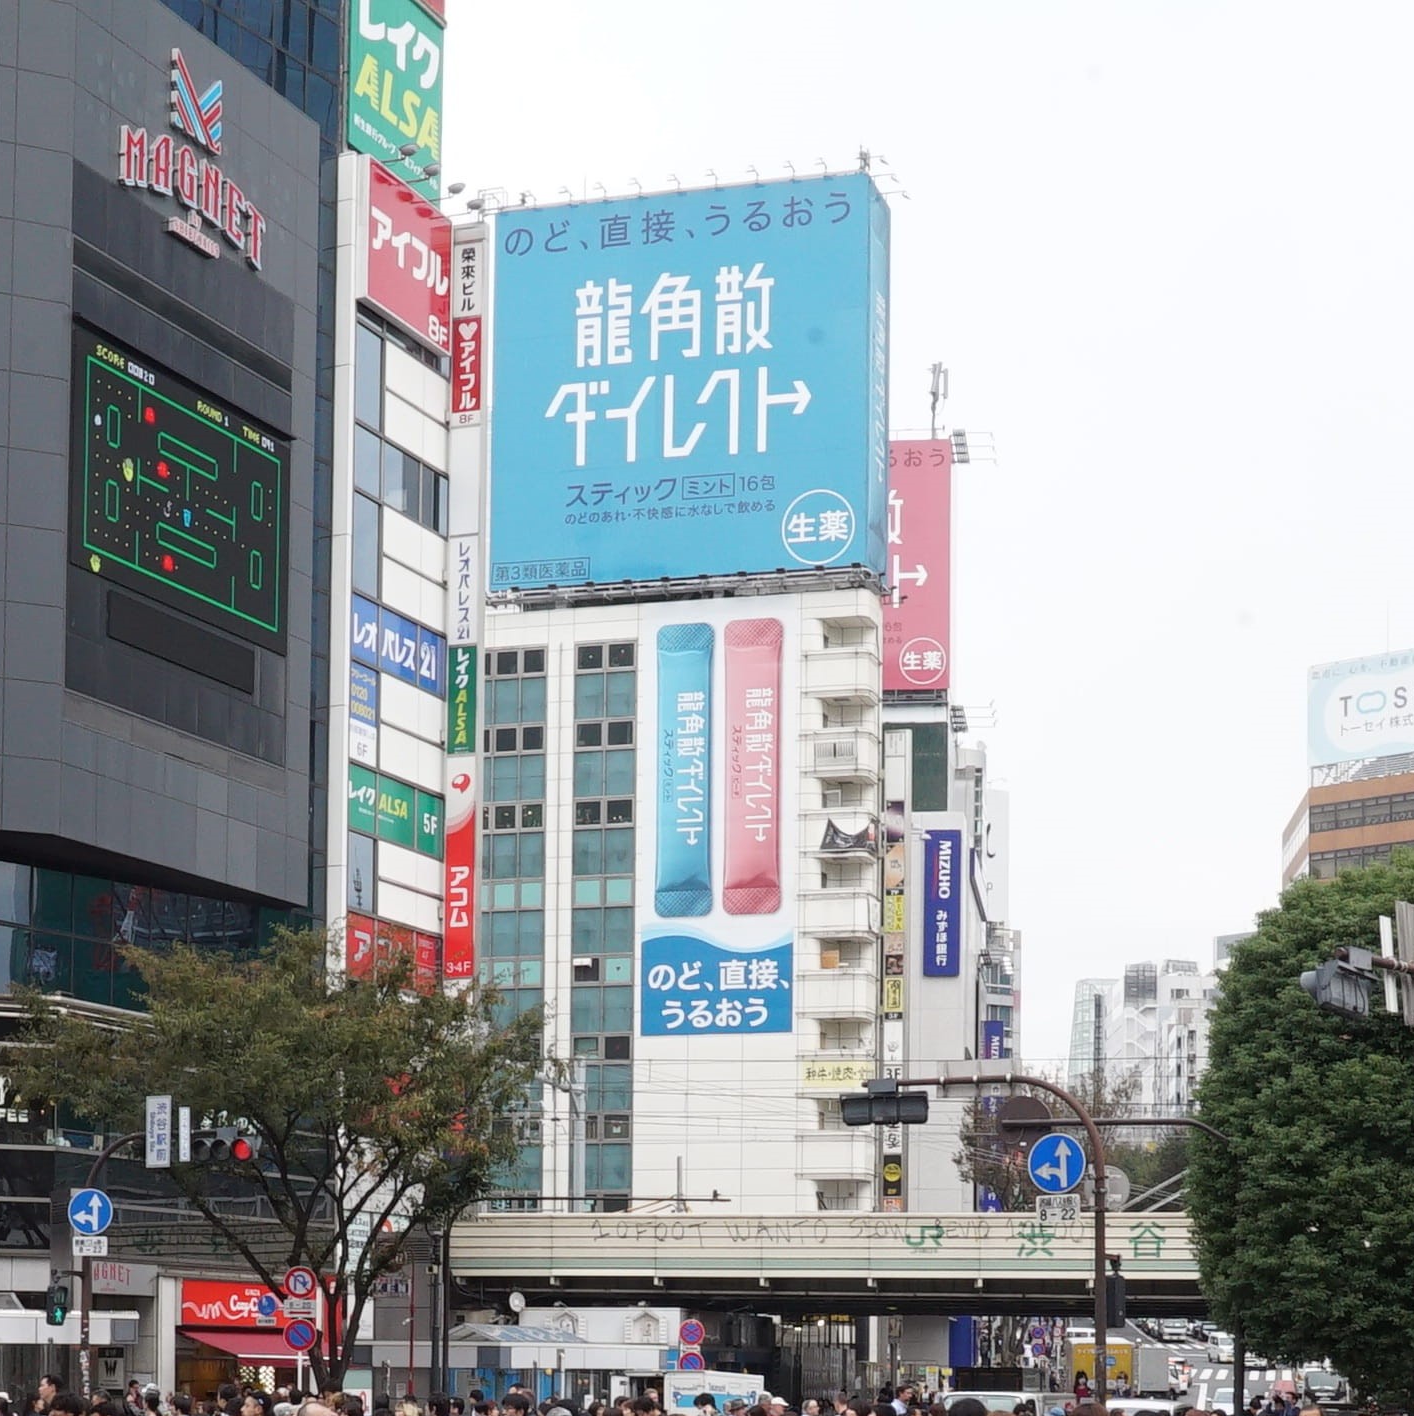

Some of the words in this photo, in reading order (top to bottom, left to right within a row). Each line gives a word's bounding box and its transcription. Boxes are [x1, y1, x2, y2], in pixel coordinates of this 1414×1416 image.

[354, 53, 440, 162] ALSA
[119, 124, 267, 271] MAGNET
[505, 191, 852, 258] のど、直接、うるおう
[369, 208, 450, 297] アイフル
[426, 314, 449, 346] 8F
[575, 263, 774, 368] 龍角散
[95, 345, 125, 369] SCORE
[458, 340, 476, 411] アイフル
[458, 415, 475, 424] 8F
[544, 367, 812, 467] ダイレクト
[242, 425, 260, 445] TIME
[565, 477, 678, 509] スティック
[685, 479, 733, 497] ミント
[739, 475, 776, 493] 16包
[564, 500, 776, 525] のどのあれ・不快感に水なしで飲める
[787, 510, 850, 544] 生薬
[494, 564, 589, 582] 第3類医薬品
[457, 541, 471, 640] レオパレス21
[353, 612, 436, 681] レオパレス21
[903, 650, 944, 672] 生薬
[677, 691, 705, 846] 龍角散ダイレクト
[745, 688, 773, 842] 龍角散ダイレクト
[348, 780, 375, 807] レイク
[378, 793, 408, 820] ALSA
[423, 813, 437, 835] 5F
[939, 840, 951, 898] MIZUHO
[449, 866, 470, 928] アコム
[936, 910, 947, 966] みずほ銀行
[648, 959, 789, 990] のど、直接、
[661, 1000, 769, 1028] うるおう
[1040, 1208, 1076, 1221] 8-22
[905, 1225, 944, 1247] JR
